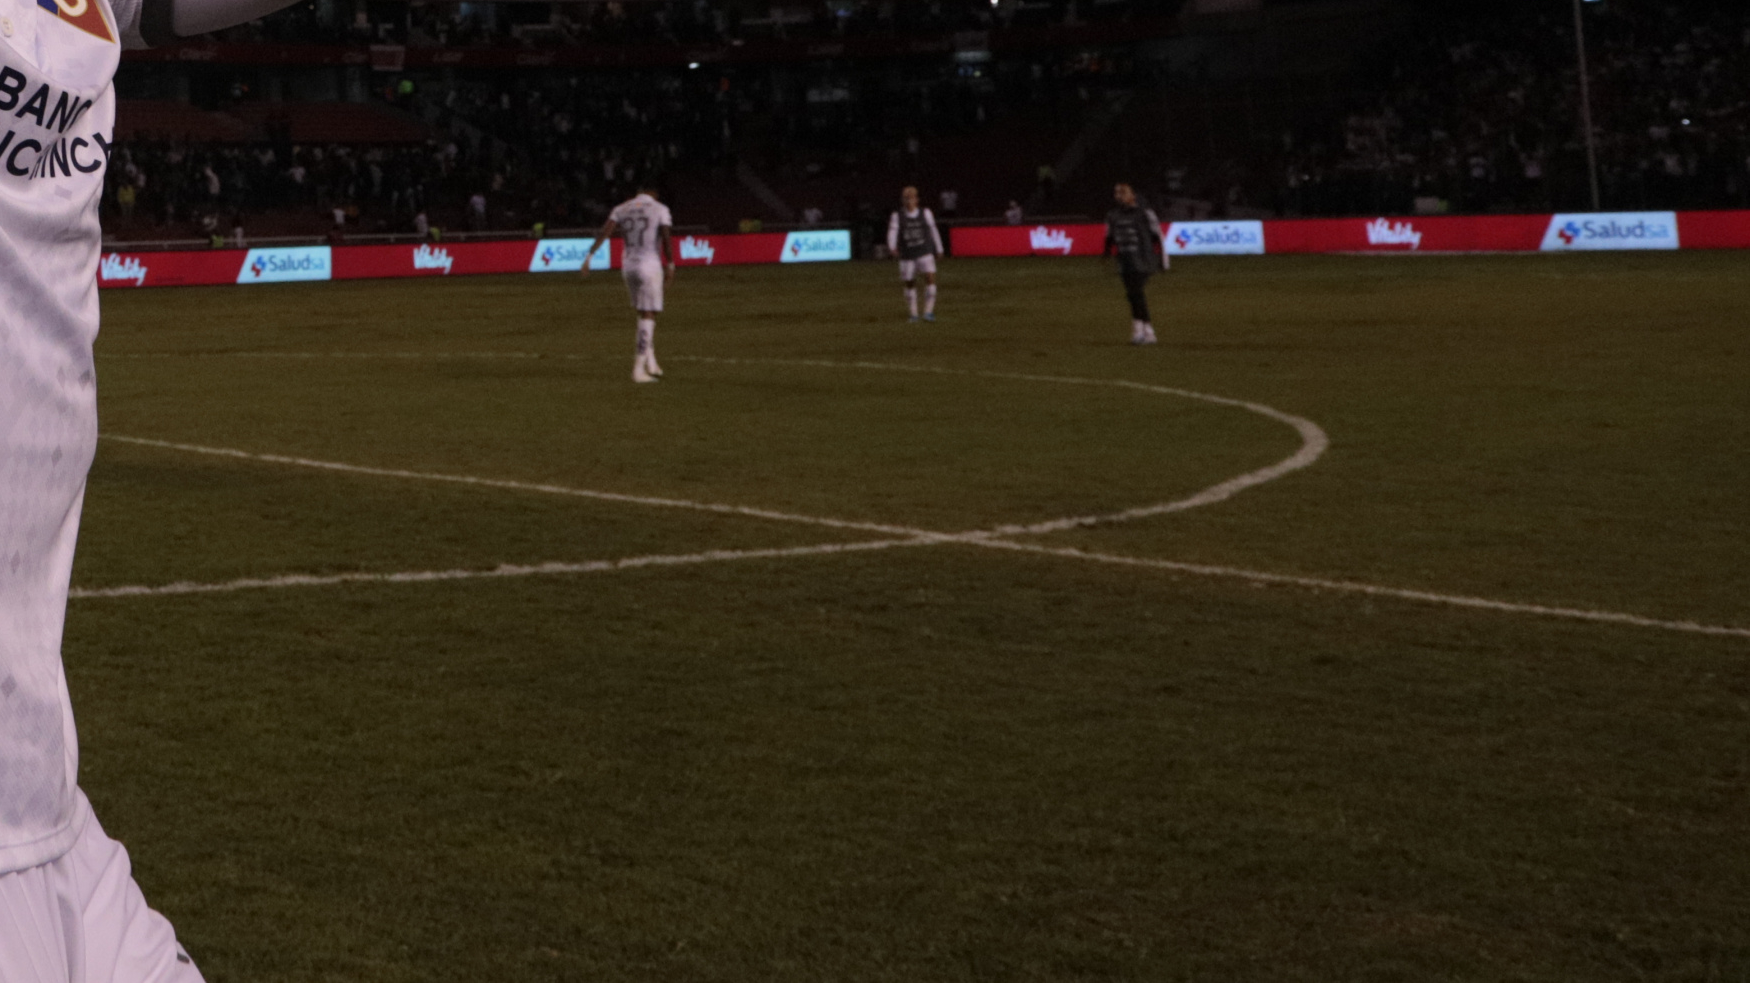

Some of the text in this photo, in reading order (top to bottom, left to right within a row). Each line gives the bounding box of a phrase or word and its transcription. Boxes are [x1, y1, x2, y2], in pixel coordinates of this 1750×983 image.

[1193, 228, 1258, 246] Saludsa
[1582, 220, 1670, 240] Saludsa
[802, 236, 848, 253] Saludsa
[268, 254, 325, 272] Saludsa
